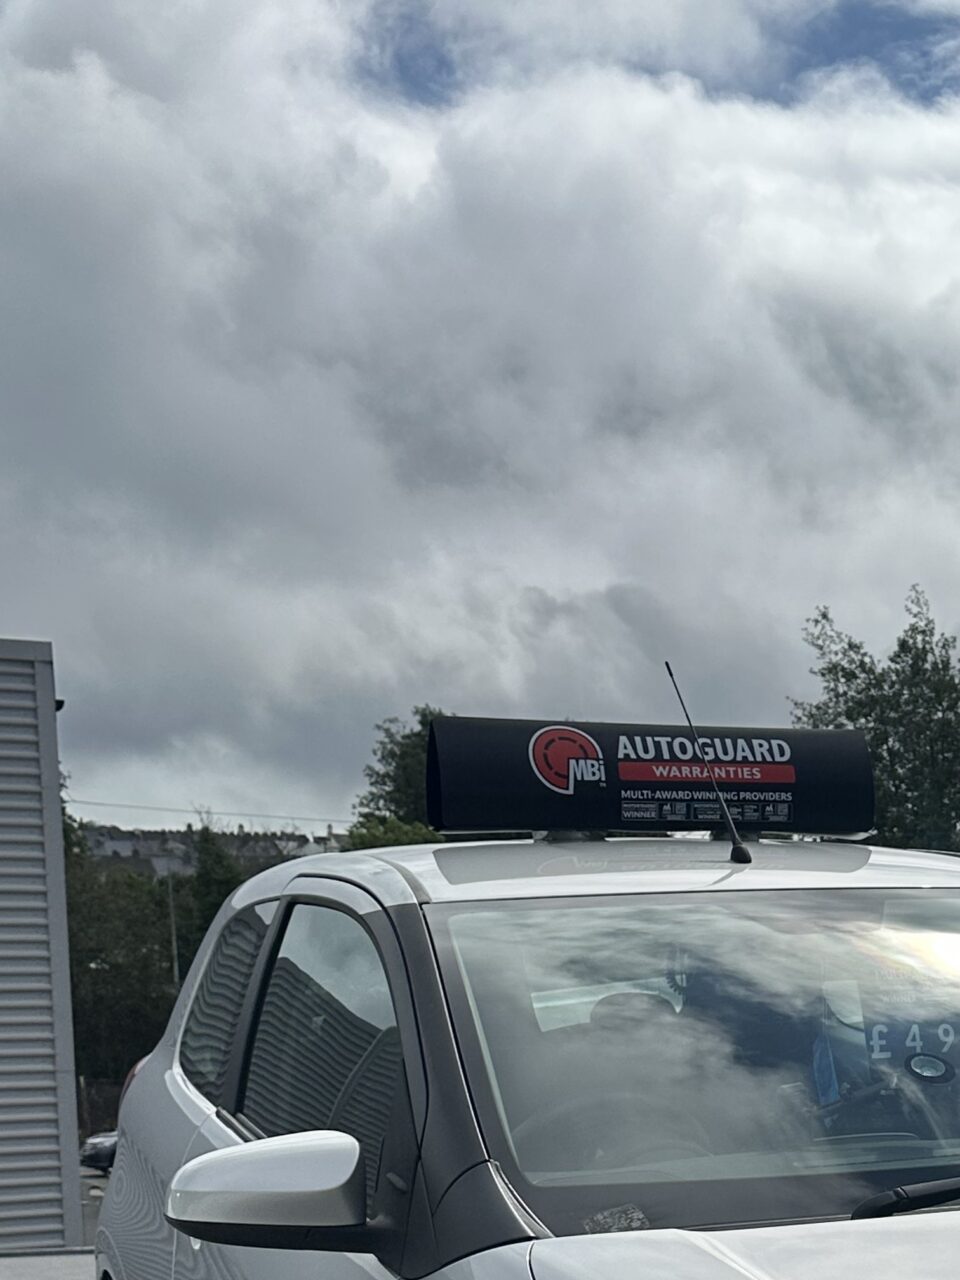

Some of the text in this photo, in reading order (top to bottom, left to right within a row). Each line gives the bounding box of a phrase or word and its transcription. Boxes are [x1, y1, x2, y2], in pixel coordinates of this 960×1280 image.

[617, 735, 791, 762] AUTOGUARD
[652, 765, 762, 780] WARRANTIES
[621, 789, 692, 801] MULTI-AWARD
[739, 791, 792, 802] PROVIDERS
